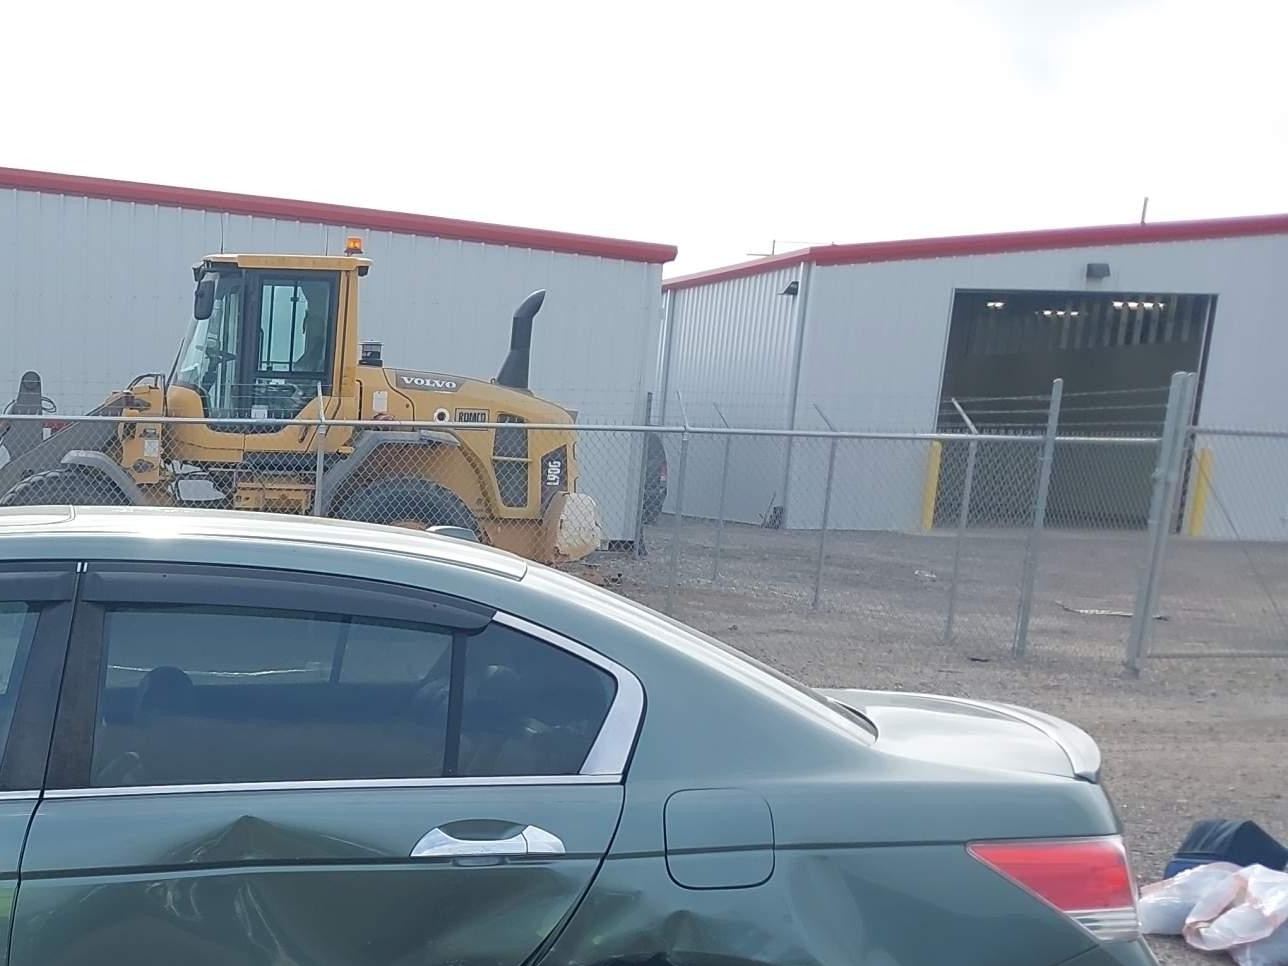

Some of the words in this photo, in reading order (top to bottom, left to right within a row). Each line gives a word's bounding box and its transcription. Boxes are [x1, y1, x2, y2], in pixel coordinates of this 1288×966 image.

[401, 376, 457, 388] VOLVO
[458, 411, 487, 422] ROMCO
[546, 460, 562, 486] L90G
